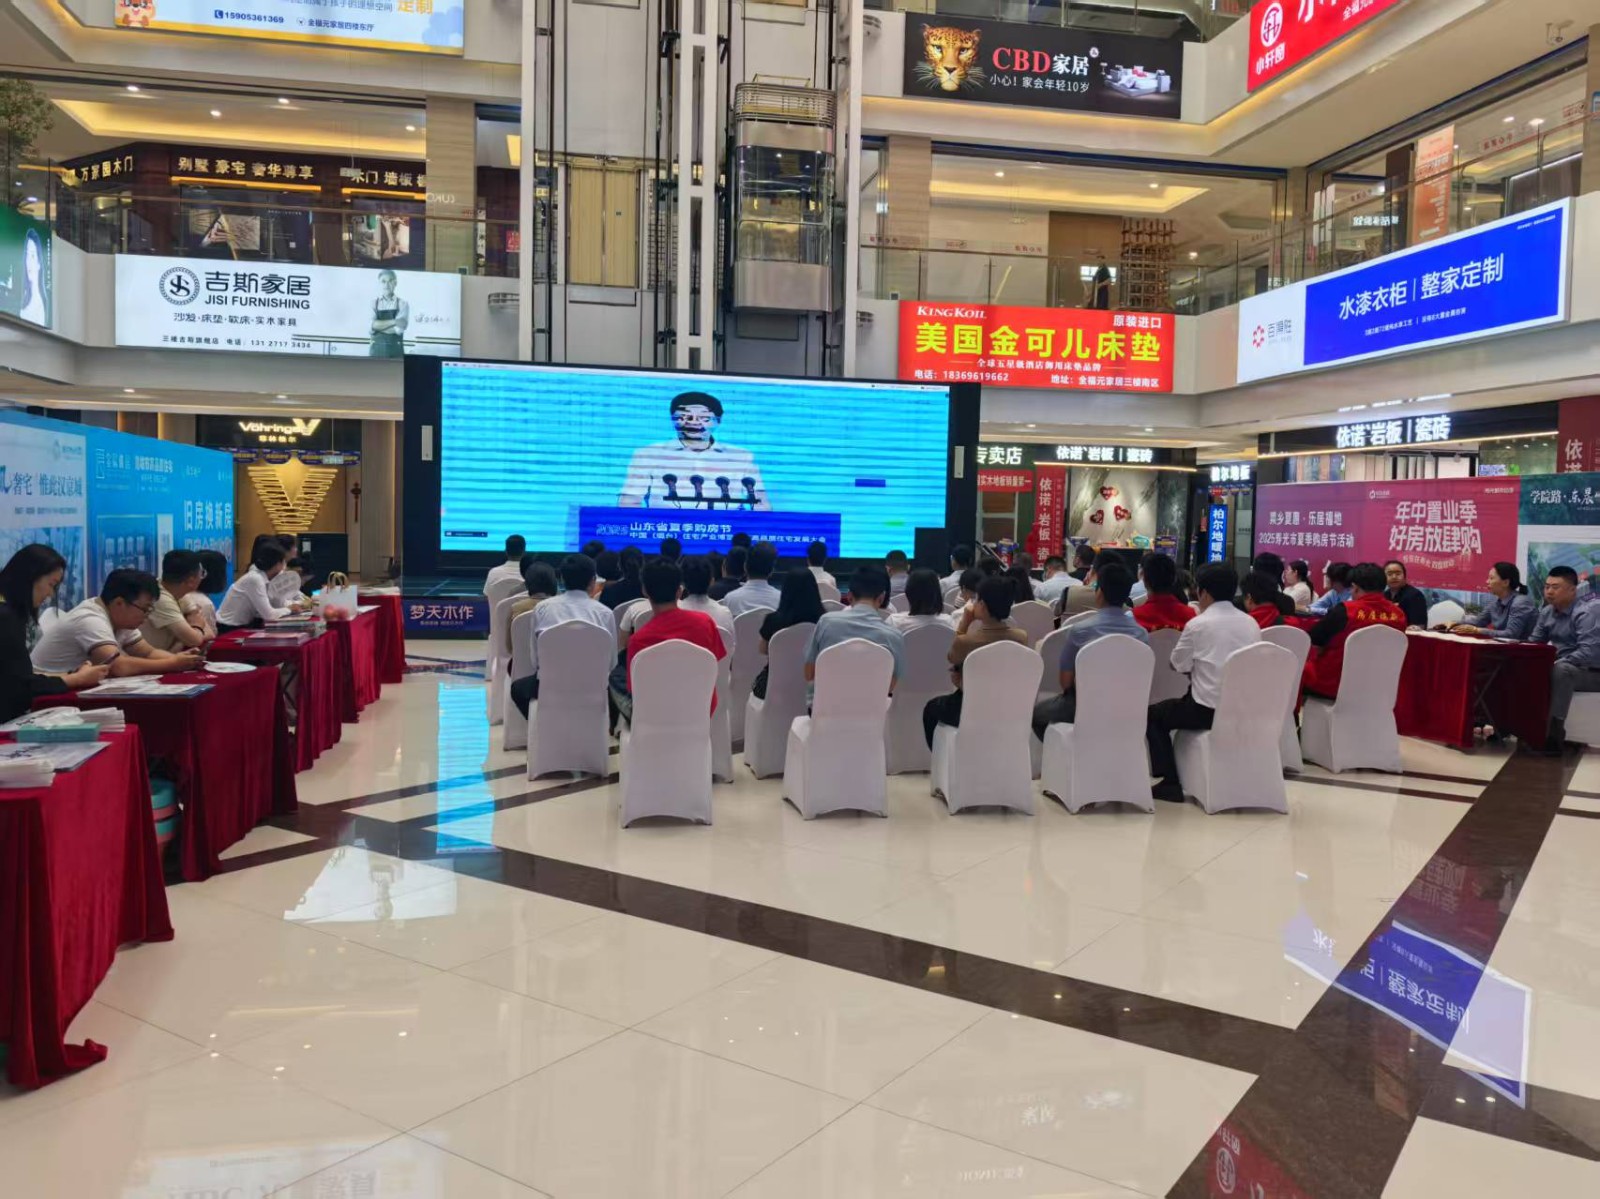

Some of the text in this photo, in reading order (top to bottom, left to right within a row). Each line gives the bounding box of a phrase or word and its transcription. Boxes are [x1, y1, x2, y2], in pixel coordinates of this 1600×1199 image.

[224, 11, 284, 23] 15905361369
[992, 47, 1089, 75] CBD家居
[204, 271, 311, 296] 吉斯家居
[1338, 253, 1504, 321] 水漆衣柜 整家定制
[205, 294, 311, 310] JISI FURNISHING
[1113, 314, 1163, 329] 原装进口
[915, 322, 1162, 362] 美国金可儿床垫
[1395, 499, 1478, 525] 年中置业季
[1389, 524, 1482, 555] 好房放肆购
[410, 605, 474, 620] 梦天木作
